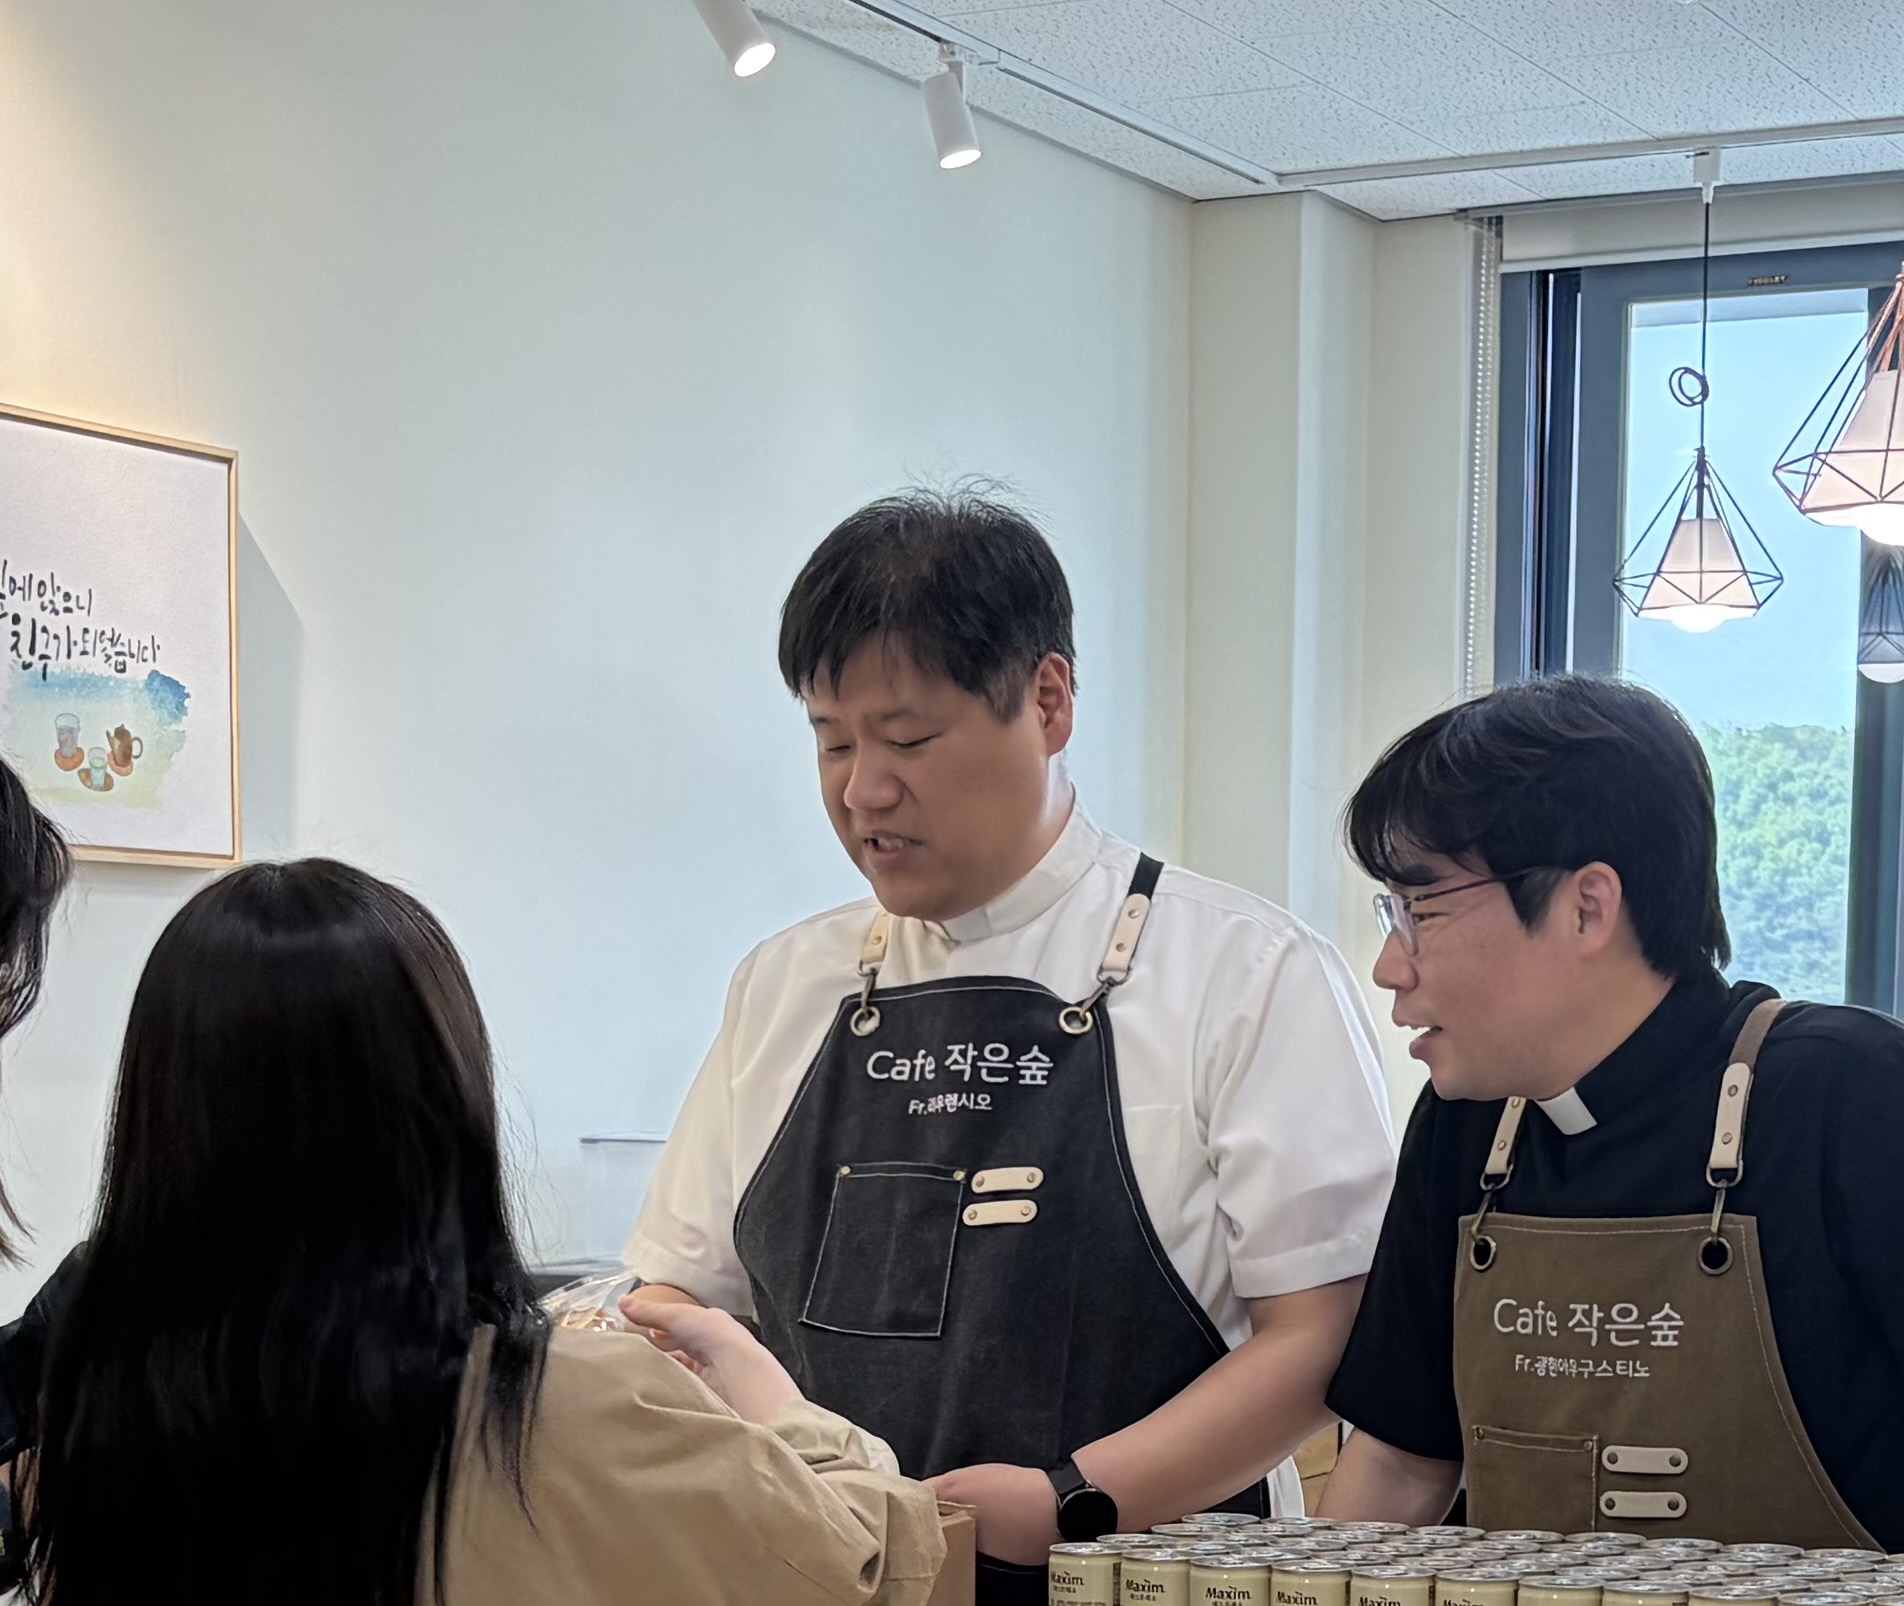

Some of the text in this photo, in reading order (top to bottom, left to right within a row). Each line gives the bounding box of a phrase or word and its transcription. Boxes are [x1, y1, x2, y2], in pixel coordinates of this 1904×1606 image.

[866, 1048, 937, 1082] Cafe
[1493, 1298, 1558, 1338] Cafe
[1125, 1578, 1166, 1595] Maxim
[1205, 1585, 1252, 1601] Maxim
[1275, 1590, 1318, 1606] Maxim
